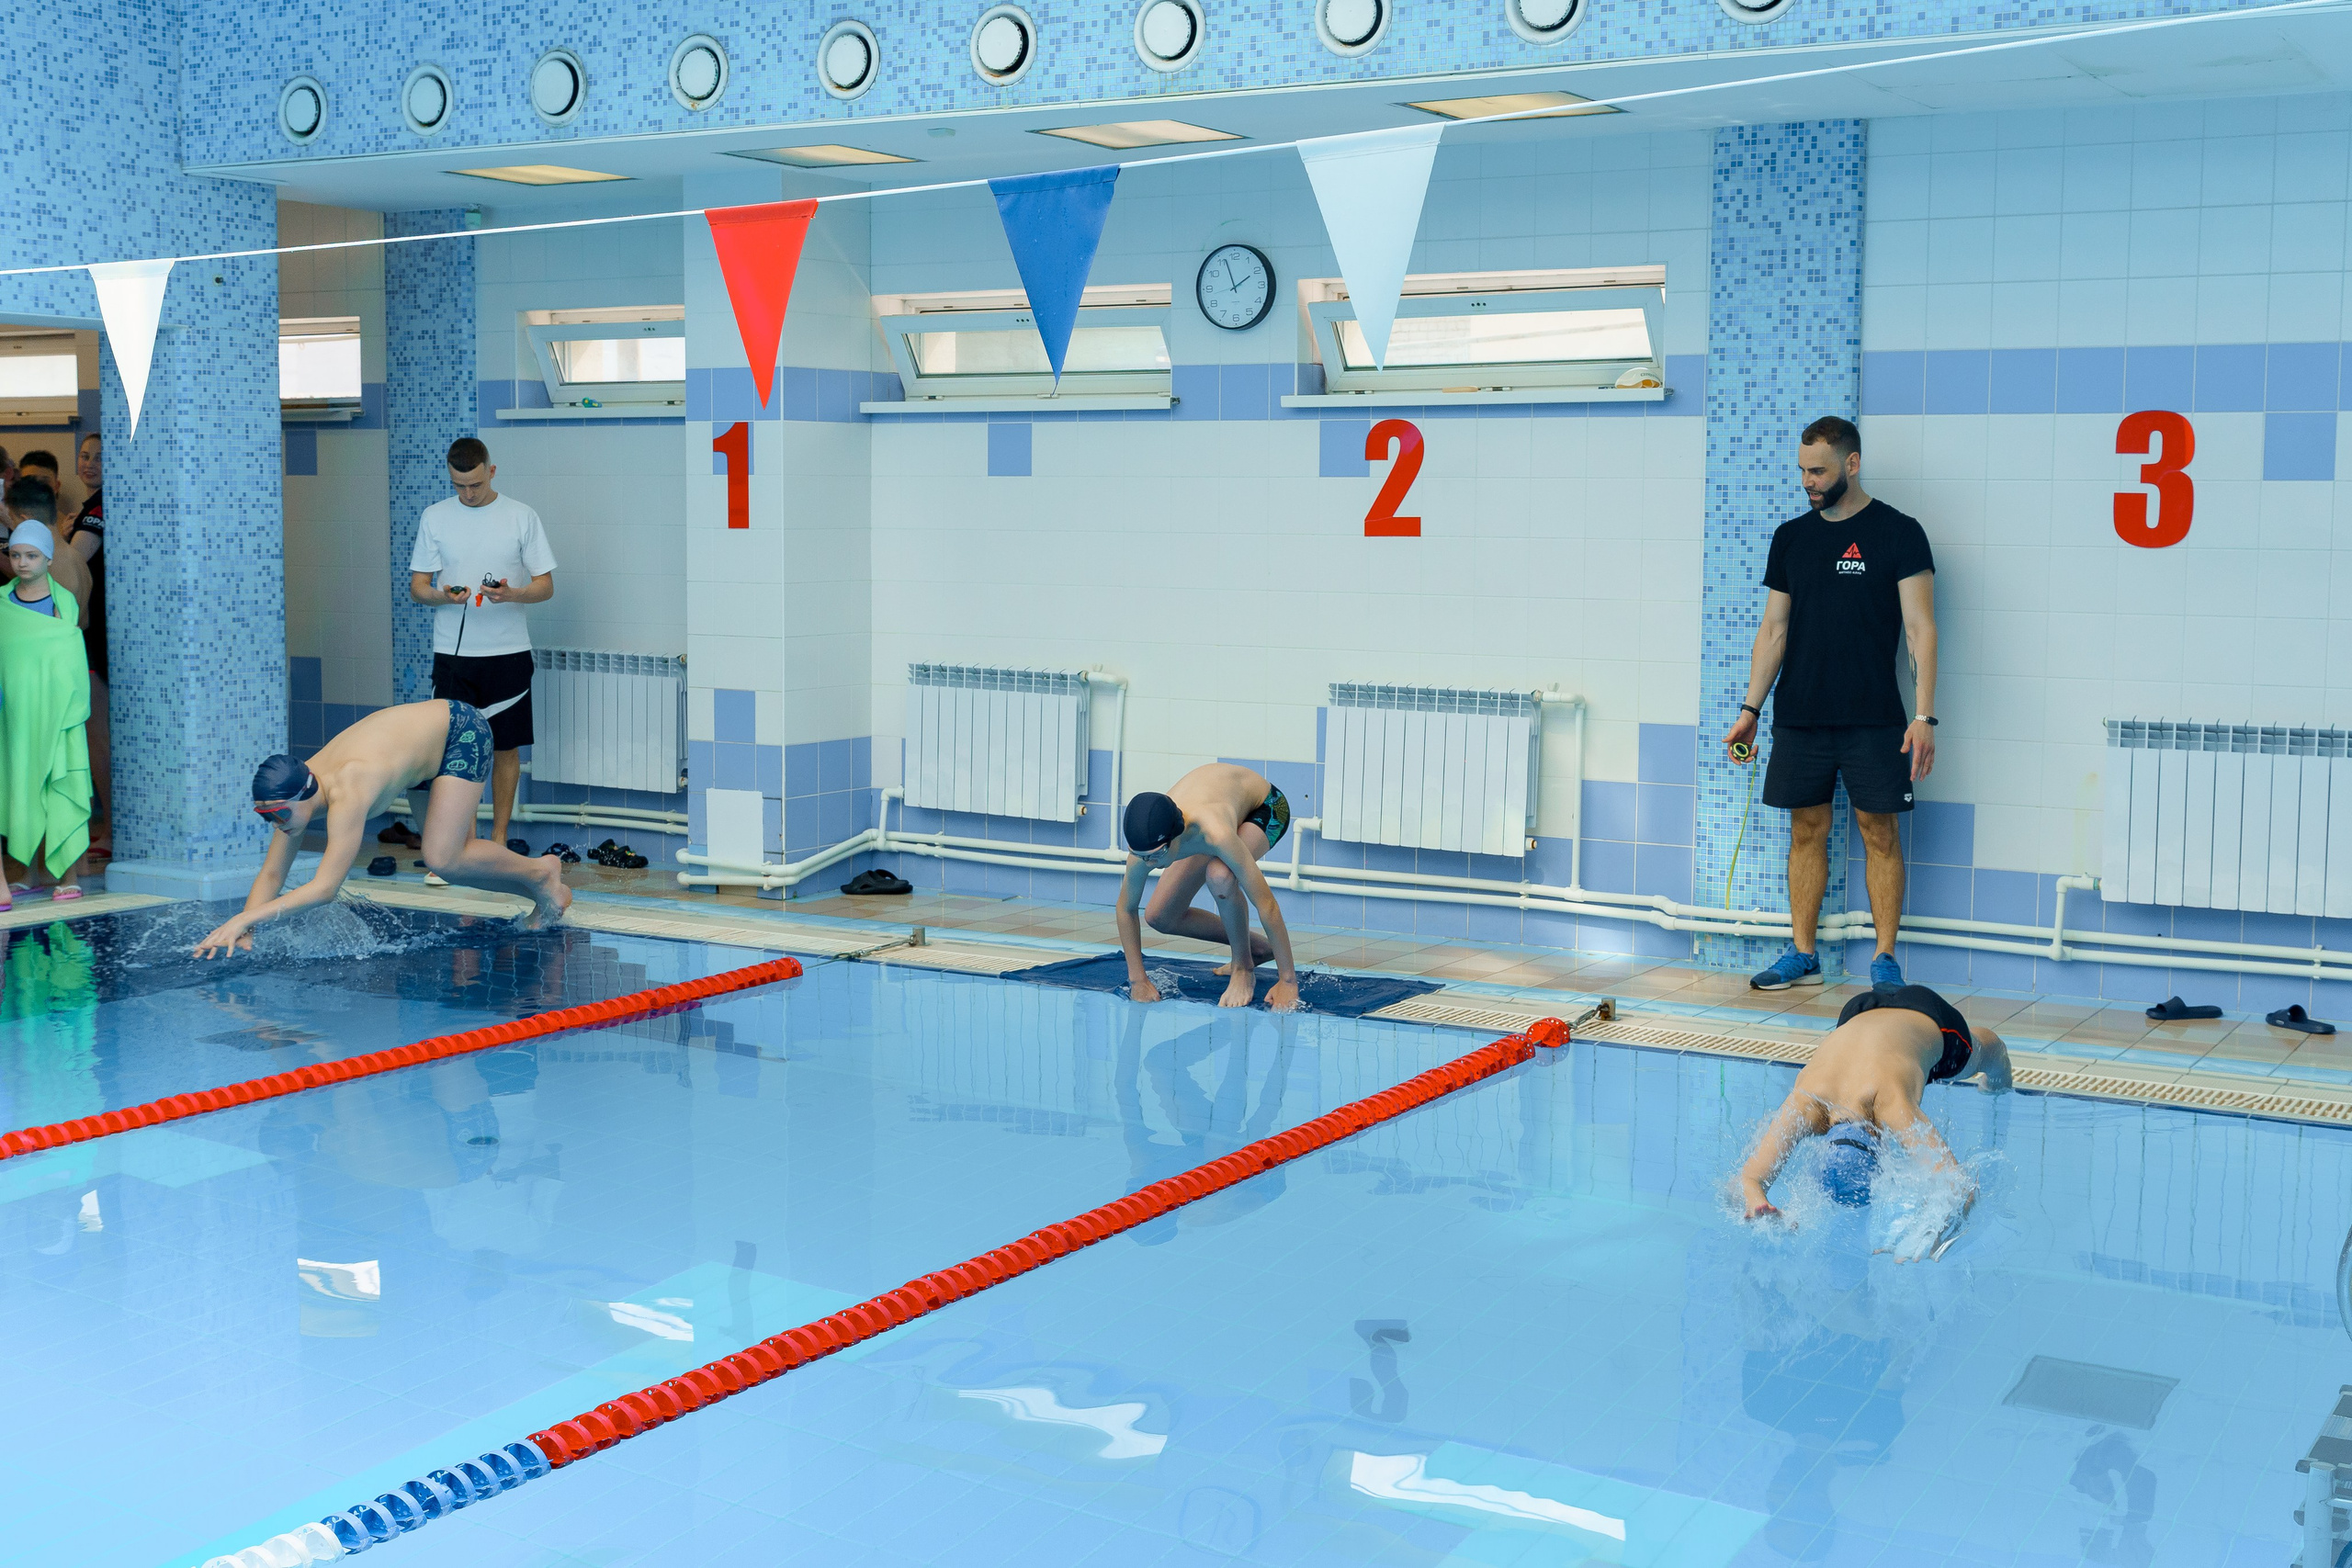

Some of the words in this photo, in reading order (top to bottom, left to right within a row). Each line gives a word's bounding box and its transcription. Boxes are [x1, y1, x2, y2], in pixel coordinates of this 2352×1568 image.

[1229, 252, 1240, 260] 12
[1209, 269, 1219, 277] 10
[1253, 266, 1261, 275] 2
[1258, 280, 1265, 288] 3
[1205, 285, 1214, 293] 9
[1210, 299, 1218, 308] 8
[1254, 296, 1261, 304] 4
[1220, 310, 1227, 318] 7
[1246, 308, 1253, 316] 5
[1232, 313, 1240, 321] 6
[713, 422, 749, 529] 1
[1364, 419, 1424, 537] 2
[2114, 411, 2194, 548] 3
[1836, 560, 1866, 571] ГОРА
